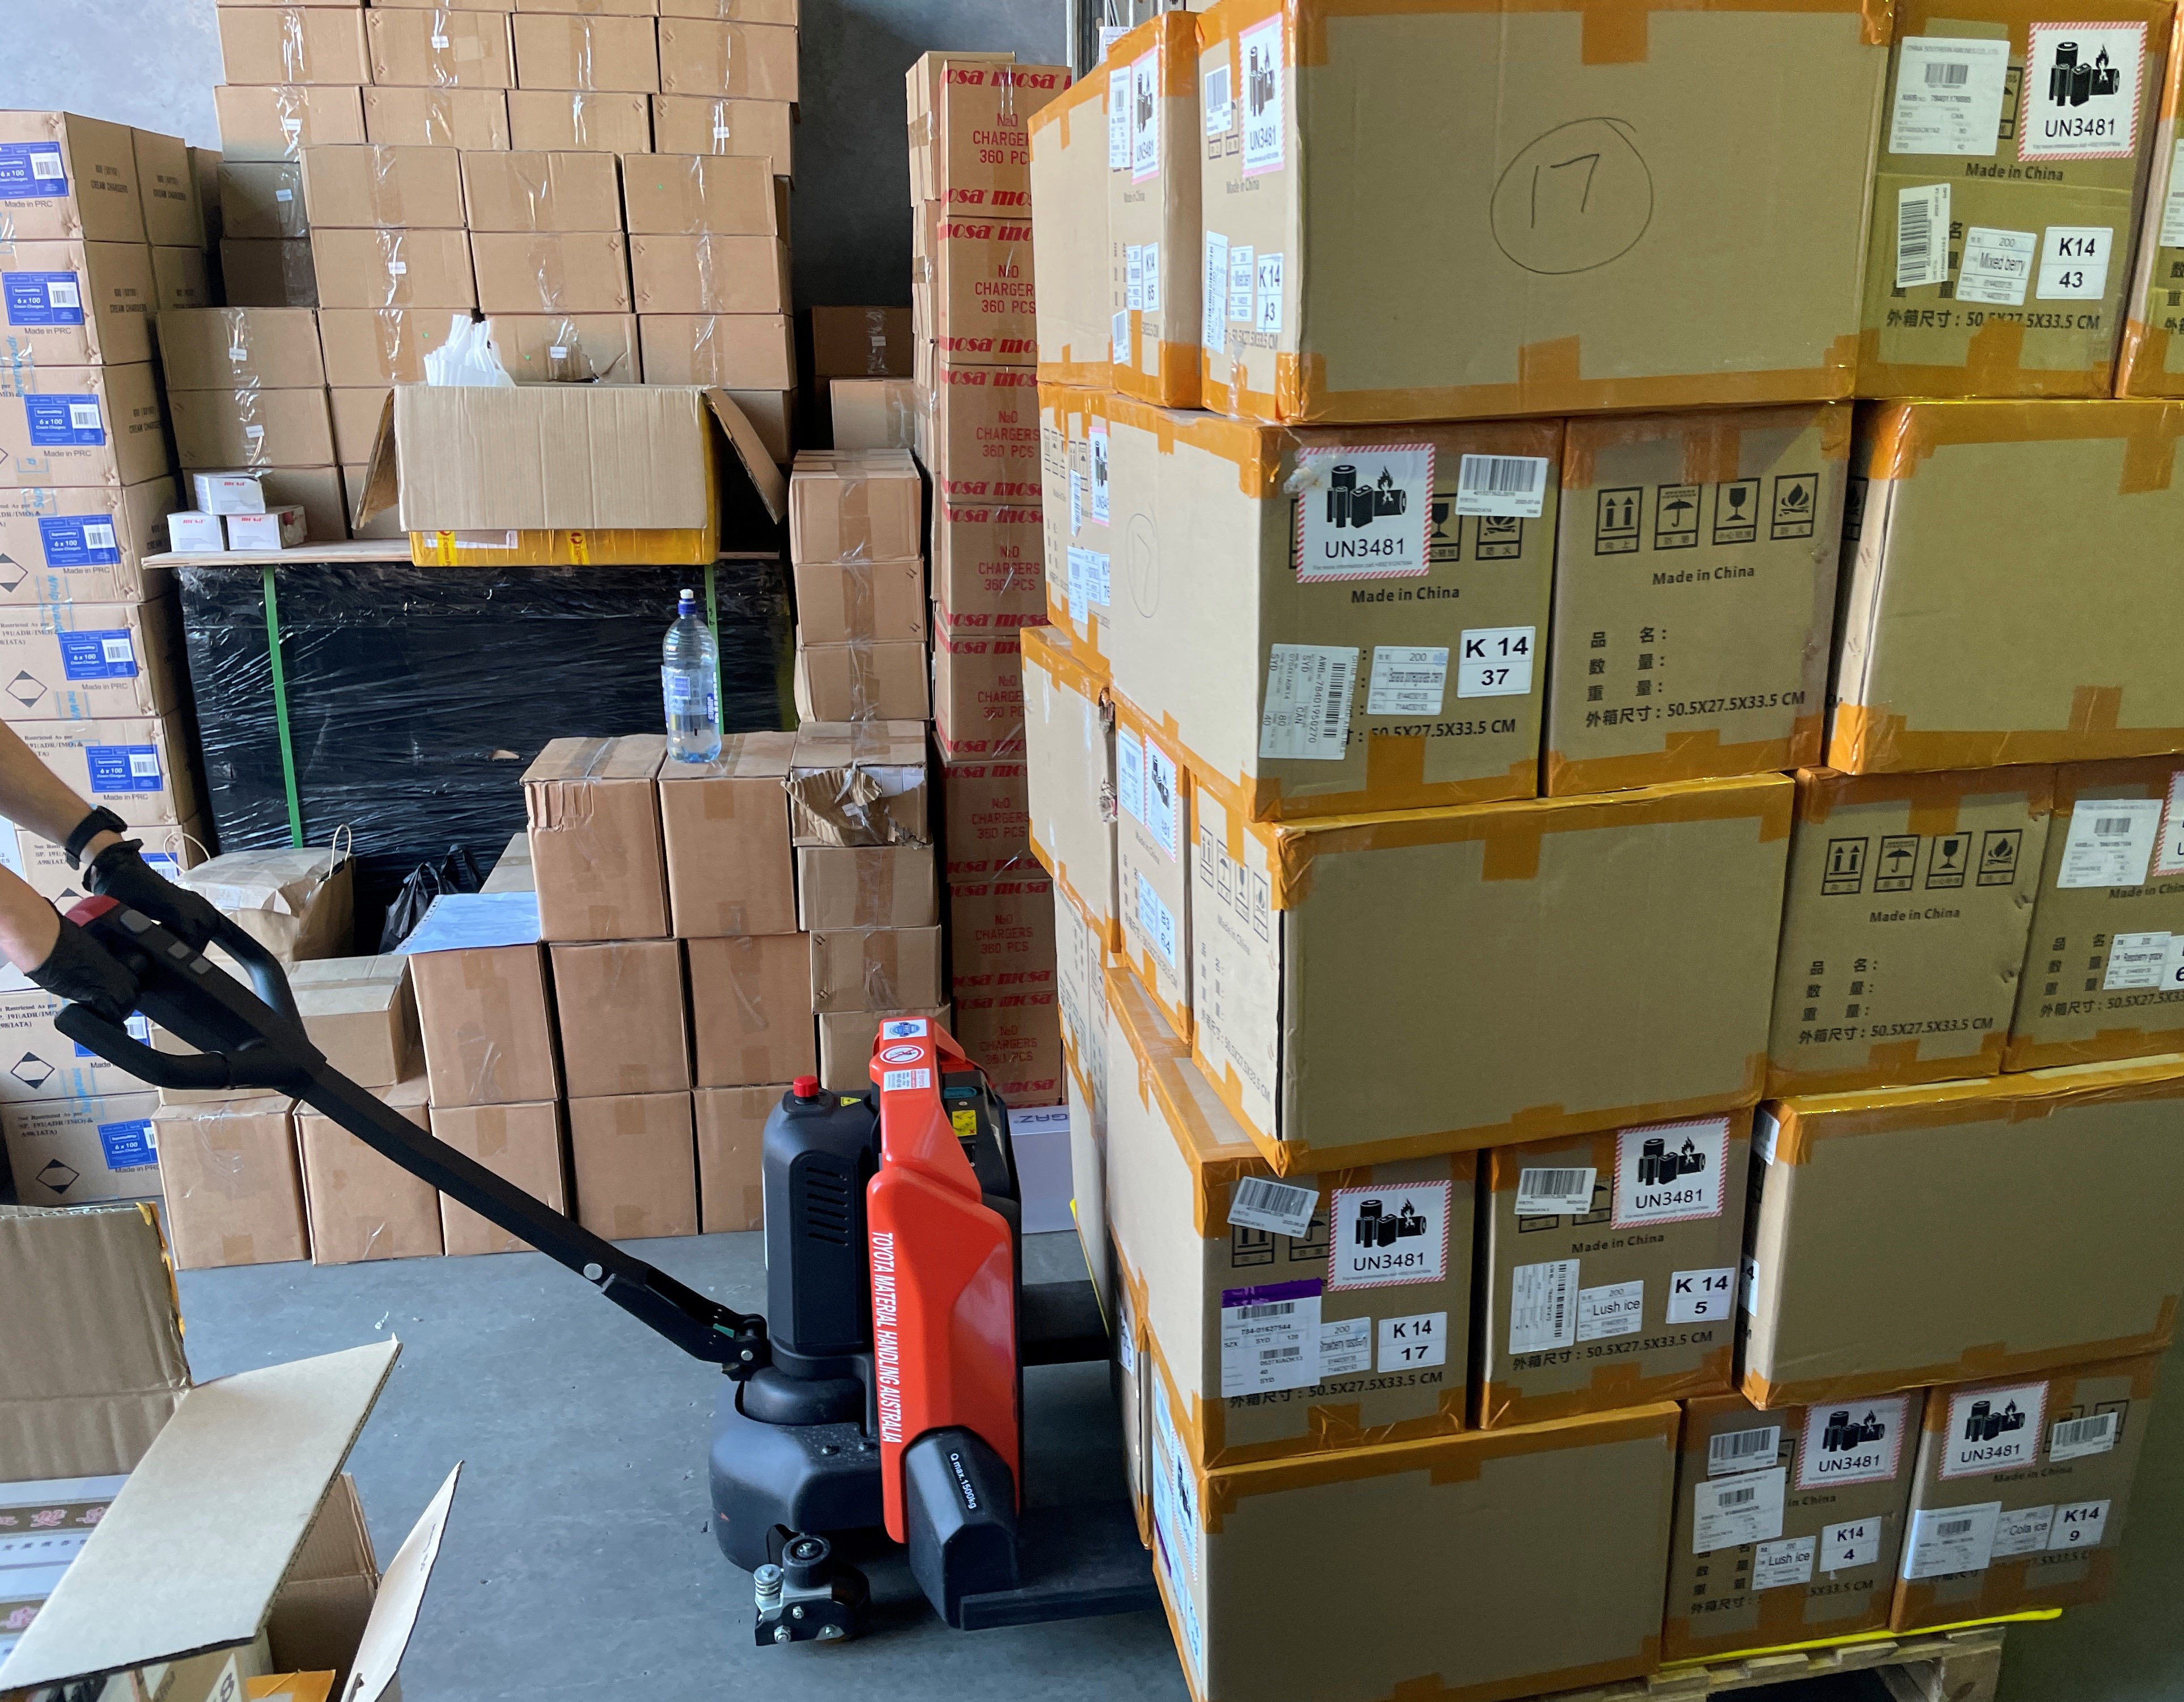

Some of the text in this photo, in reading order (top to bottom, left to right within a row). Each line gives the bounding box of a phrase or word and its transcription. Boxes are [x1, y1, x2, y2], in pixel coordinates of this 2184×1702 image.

[2045, 118, 2115, 138] UN3481
[1249, 124, 1277, 151] UN3481
[979, 150, 1003, 164] 360
[1965, 163, 2064, 181] Made in China
[1531, 153, 1600, 229] 17
[1999, 237, 2016, 248] 200
[2059, 238, 2096, 257] K14
[1980, 252, 2025, 276] Mixed berry
[1259, 265, 1280, 288] K 14
[2059, 272, 2083, 288] 43
[981, 300, 1004, 313] 360
[2077, 315, 2100, 330] CM
[977, 428, 1040, 442] CHARGERS
[982, 444, 1034, 459] 360 PCS
[1325, 537, 1404, 559] UN3481
[978, 561, 1040, 575] CHARGERS
[1652, 567, 1755, 585] Made in China
[985, 578, 1036, 591] 360 PCS
[1351, 586, 1460, 603] Made in China
[1465, 636, 1529, 659] K 14
[1591, 631, 1606, 648] 品
[1269, 653, 1279, 671] SYD
[1301, 655, 1311, 673] SYD
[1317, 656, 1327, 673] AWB
[1409, 653, 1427, 662] 200
[1589, 659, 1605, 675] 数
[1481, 669, 1510, 686] 37
[1587, 685, 1604, 702] 重
[1667, 693, 1778, 718] 50.5X27.5X33.5
[1782, 691, 1805, 706] CM
[1262, 714, 1271, 726] 40
[1278, 715, 1286, 727] 80
[1294, 707, 1304, 724] CAN
[1491, 718, 1517, 733] CM
[1003, 826, 1027, 838] PCS
[2109, 885, 2156, 899] Made in
[1870, 908, 1961, 923] Made in China
[1007, 940, 1029, 953] PCS
[1809, 961, 1824, 975] 品
[1871, 1018, 1969, 1038] 50.5X27.5X33.5
[1972, 1017, 1994, 1030] CM
[1020, 1113, 1068, 1123] GAZ
[1635, 1189, 1704, 1209] UN3481
[1571, 1233, 1665, 1254] Made in China
[1354, 1251, 1424, 1271] UN3481
[1608, 1288, 1625, 1297] 200
[1675, 1275, 1729, 1294] K 14
[1593, 1299, 1641, 1317] Lush ice
[1694, 1300, 1708, 1315] 5
[871, 1231, 902, 1443] TOYOTA MATERIAL HANDLING AUSTRALIA
[1334, 1325, 1350, 1334] 200
[1393, 1319, 1432, 1339] K 14
[1587, 1335, 1687, 1359] 50.5X27.5X33.5
[1691, 1330, 1714, 1344] CM
[1401, 1346, 1429, 1361] 17
[1307, 1370, 1443, 1398] 50.5X27.5X33.5 CM
[1961, 1444, 2021, 1463] UN3481
[1818, 1455, 1881, 1472] UN3481
[961, 1479, 977, 1510] 1500kg
[1787, 1494, 1837, 1507] in China
[2063, 1507, 2100, 1523] K14
[1836, 1525, 1865, 1543] K14
[2009, 1522, 2048, 1537] Cola ice
[2069, 1530, 2081, 1542] 9
[1769, 1550, 1810, 1567] Lush ice
[1843, 1548, 1855, 1561] 4
